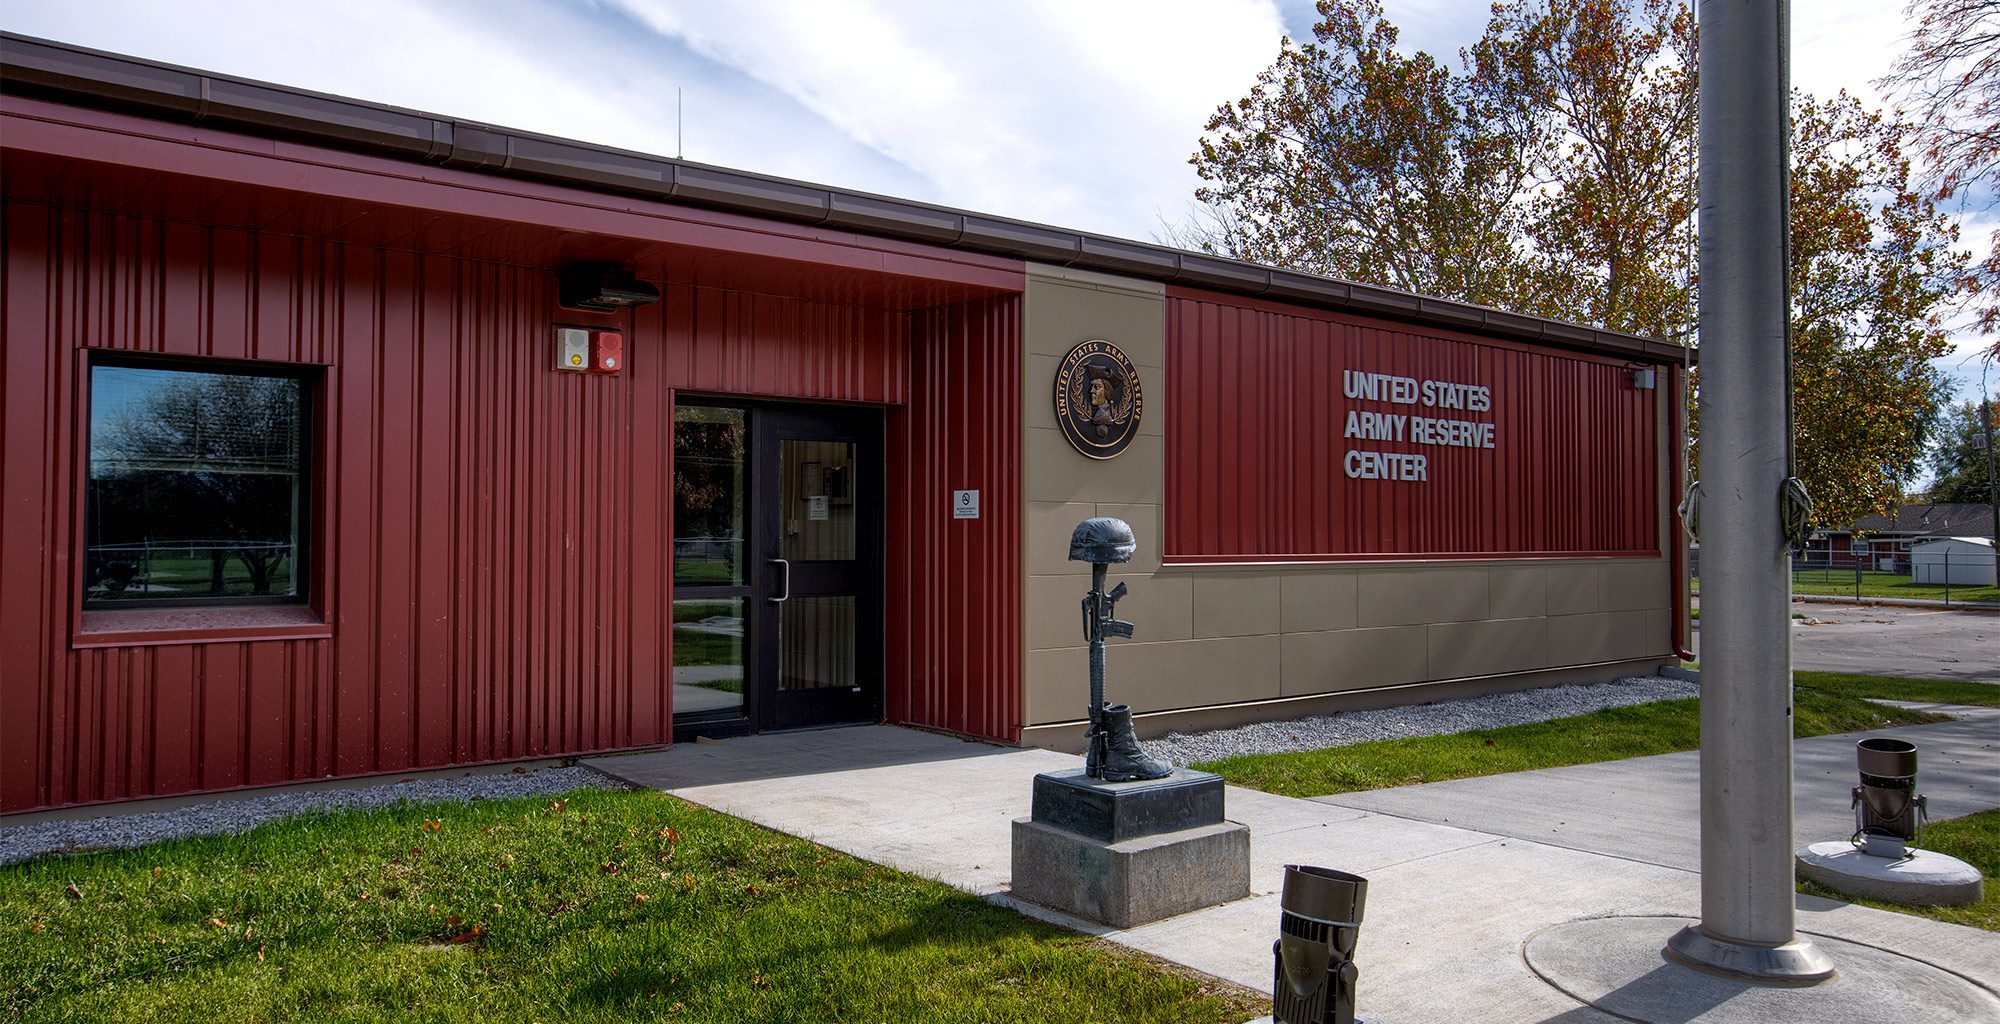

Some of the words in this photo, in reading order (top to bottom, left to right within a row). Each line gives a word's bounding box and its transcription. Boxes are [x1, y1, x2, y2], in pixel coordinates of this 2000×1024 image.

[1059, 370, 1069, 416] UNITED
[1069, 343, 1099, 365] STATES
[1105, 345, 1130, 366] ARMY
[1130, 371, 1142, 421] RESERVE
[1344, 370, 1419, 404] UNITED
[1421, 379, 1491, 412] STATES
[1344, 410, 1406, 442] ARMY
[1410, 416, 1495, 449] RESERVE
[1344, 450, 1427, 482] CENTER
